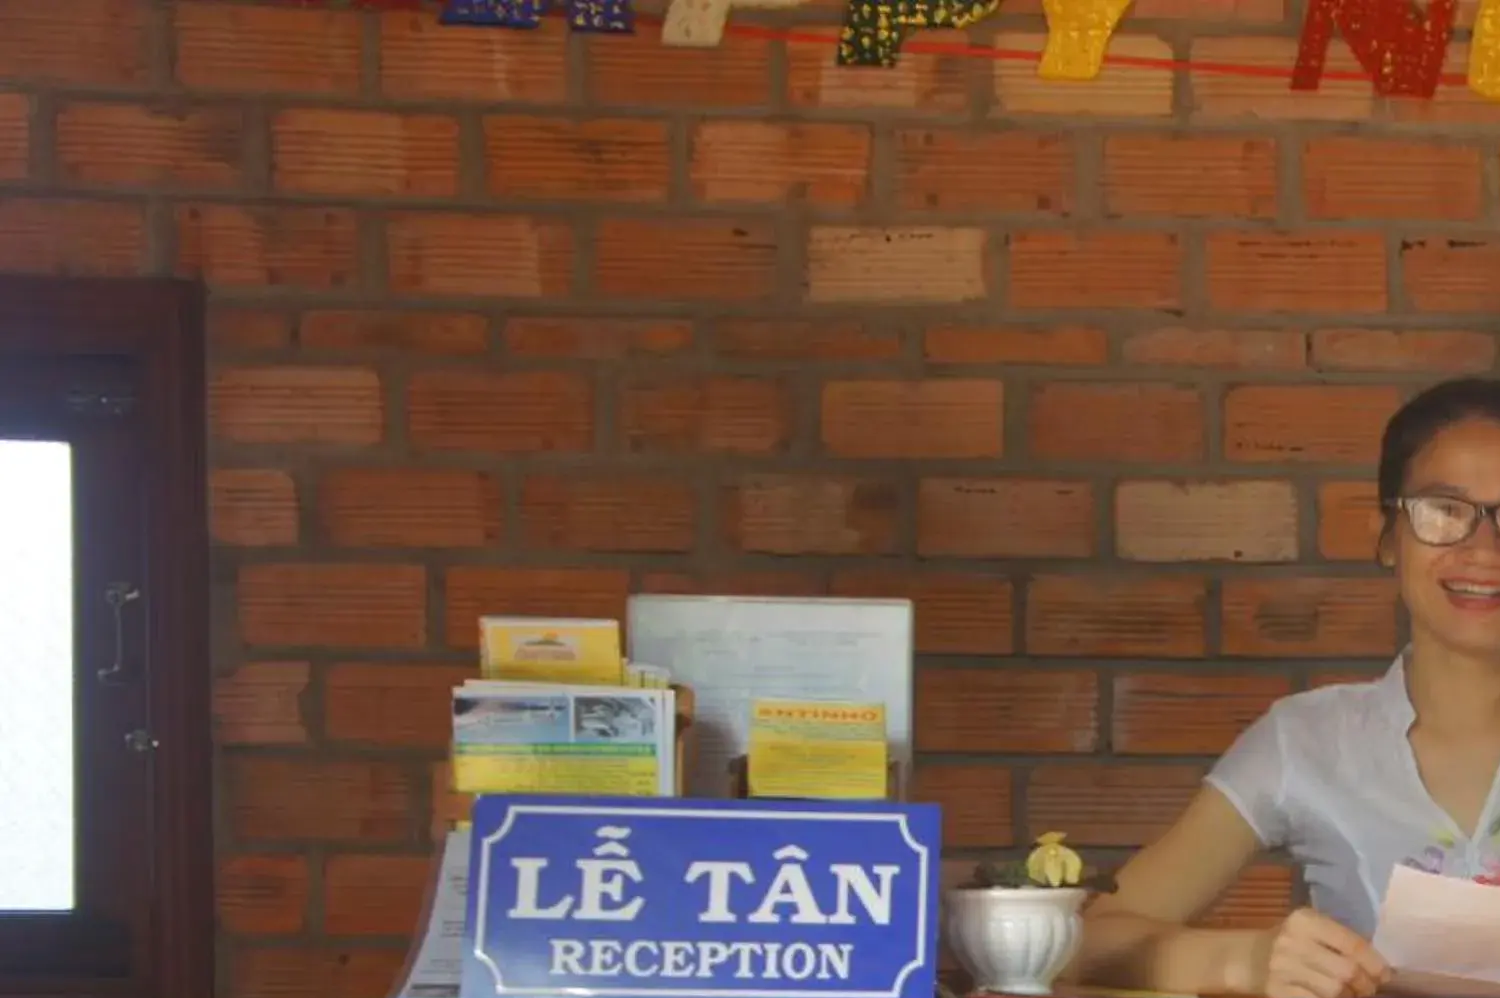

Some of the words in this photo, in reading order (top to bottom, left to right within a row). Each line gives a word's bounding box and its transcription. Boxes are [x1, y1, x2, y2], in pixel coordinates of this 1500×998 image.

[506, 825, 646, 921] LỄ
[684, 844, 901, 926] TÂN
[548, 937, 855, 981] RECEPTION
